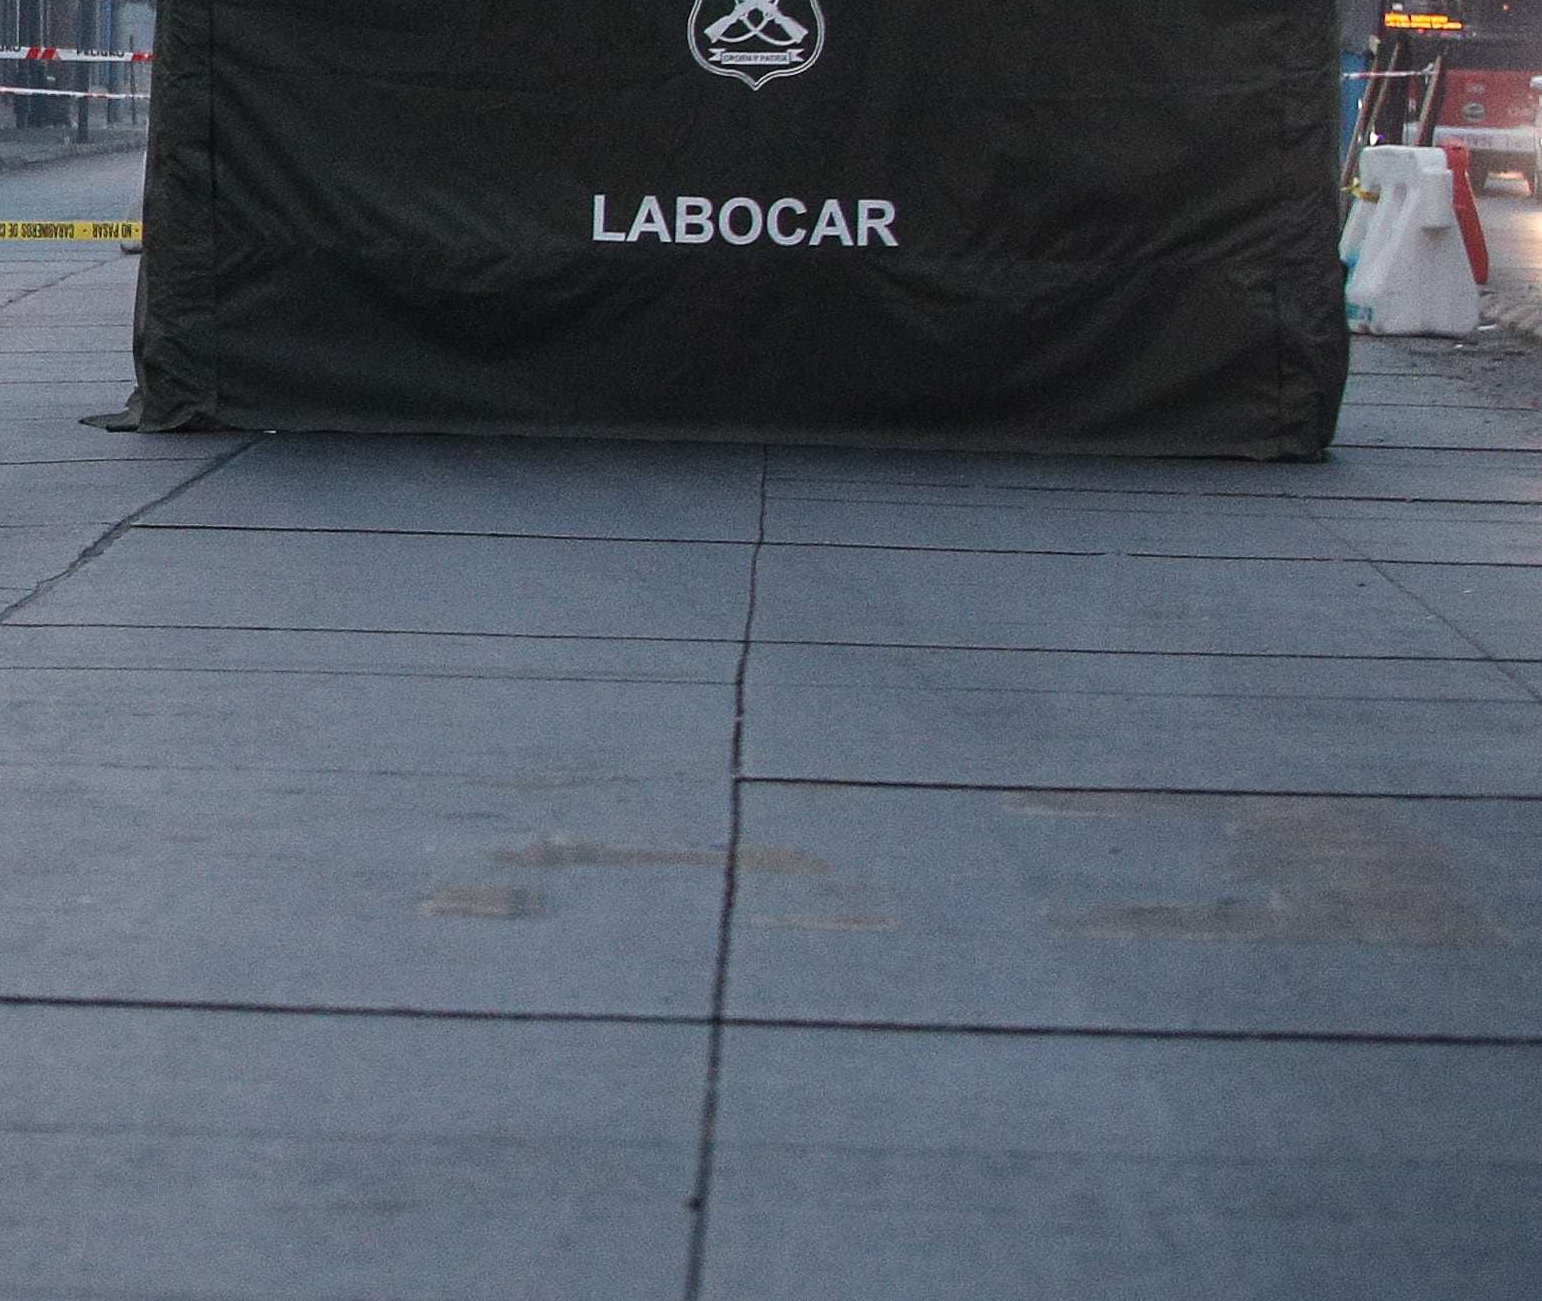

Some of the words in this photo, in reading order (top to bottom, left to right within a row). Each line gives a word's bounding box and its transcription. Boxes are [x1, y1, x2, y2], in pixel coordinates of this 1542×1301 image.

[592, 194, 899, 247] LABOCAR
[9, 222, 18, 238] DE
[21, 222, 74, 238] CARABINEROS
[92, 223, 119, 238] PASAR
[121, 223, 132, 238] NO
